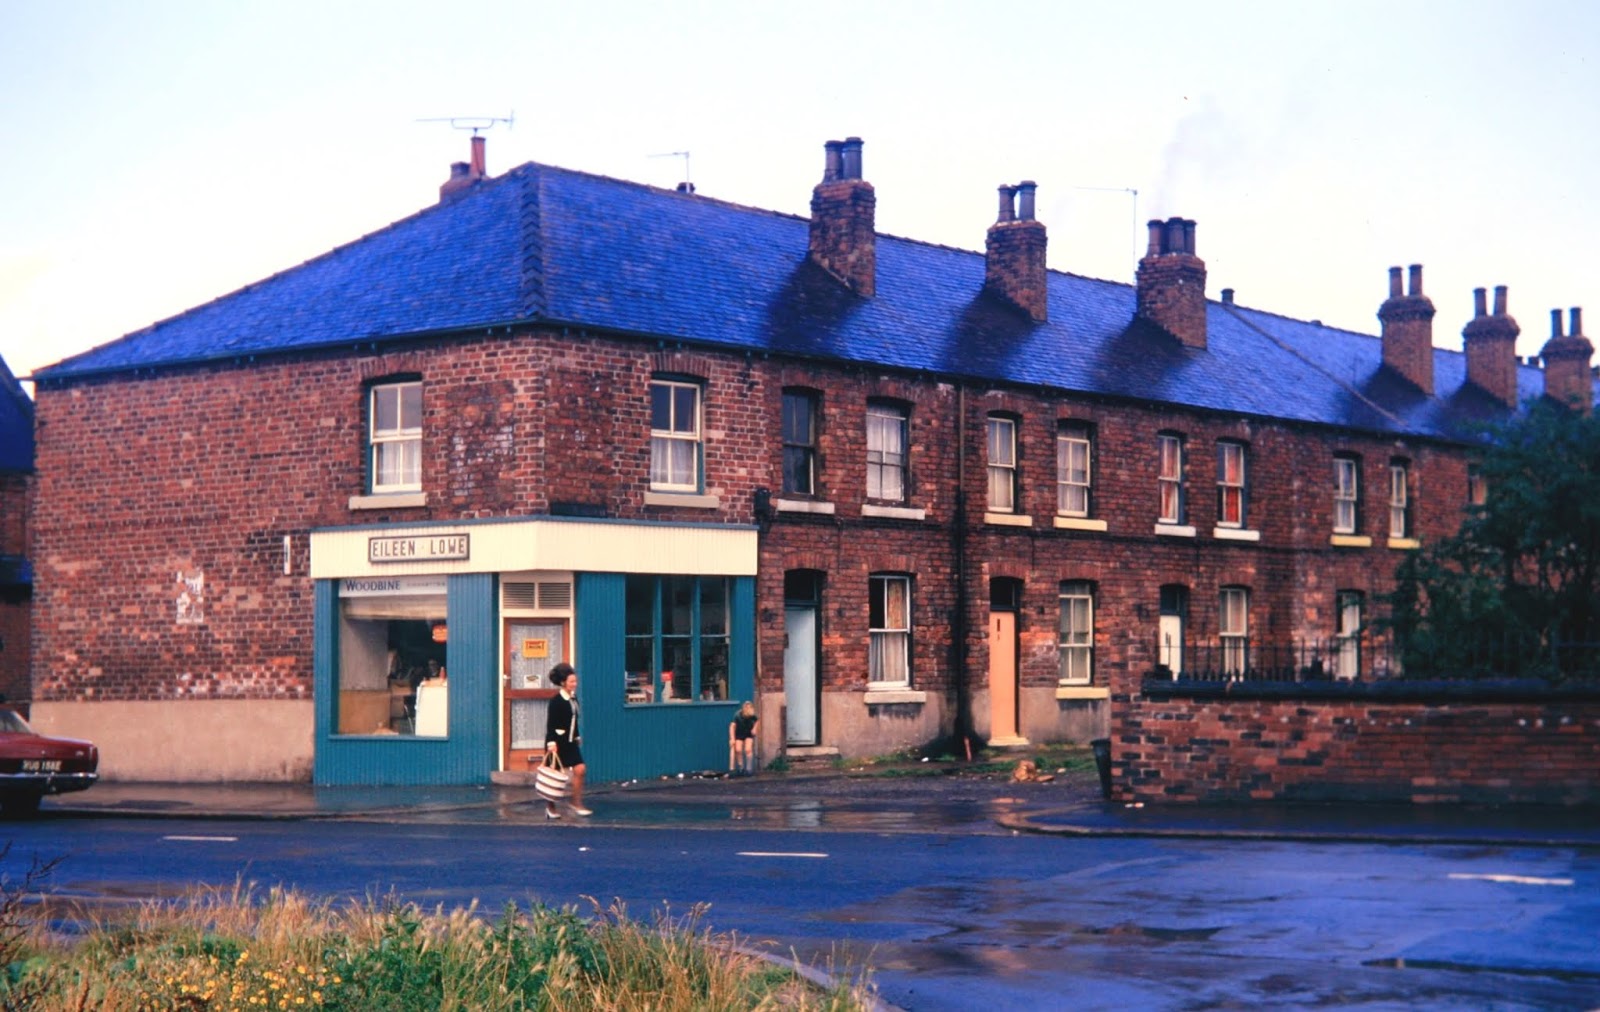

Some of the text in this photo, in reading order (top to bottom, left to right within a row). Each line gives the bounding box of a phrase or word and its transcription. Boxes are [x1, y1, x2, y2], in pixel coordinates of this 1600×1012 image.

[373, 538, 465, 556] EILEEN LOWE
[345, 580, 401, 592] WOODBINE
